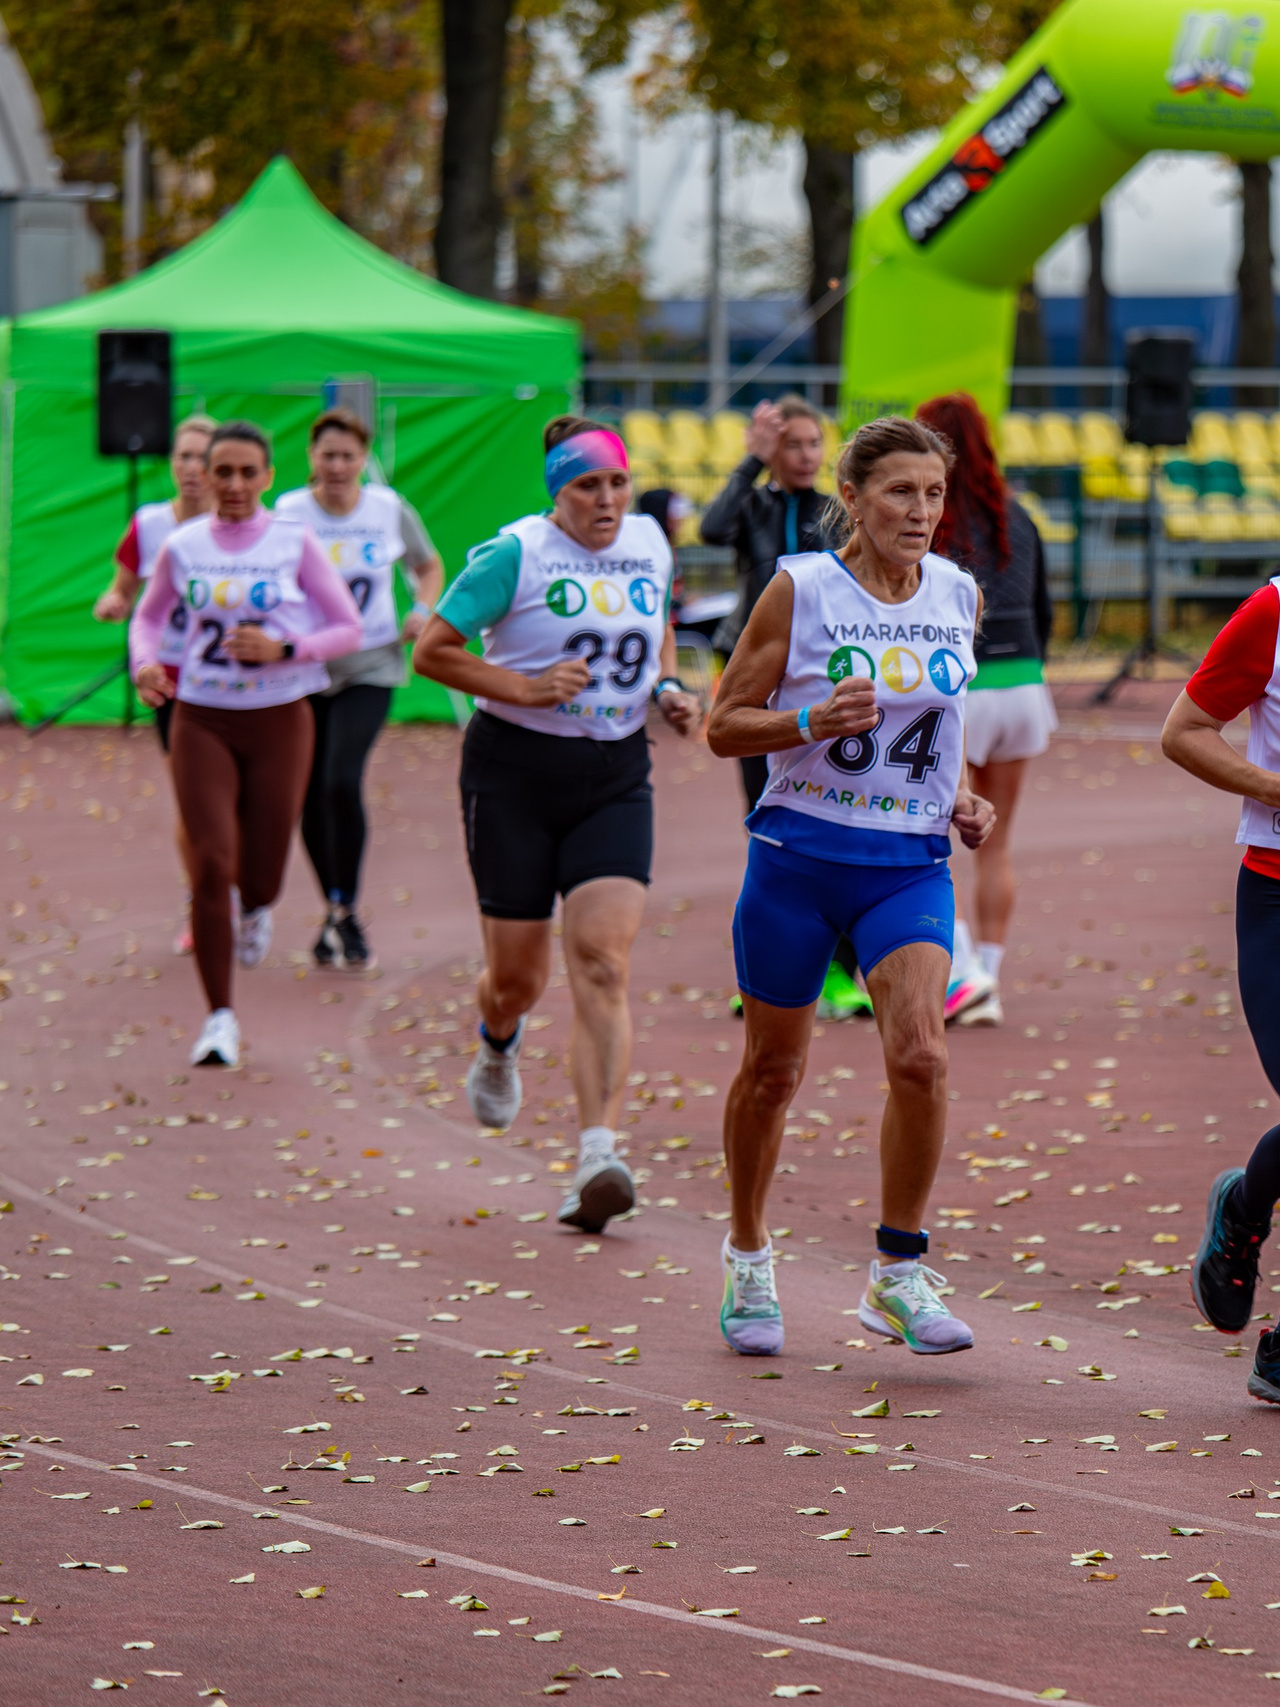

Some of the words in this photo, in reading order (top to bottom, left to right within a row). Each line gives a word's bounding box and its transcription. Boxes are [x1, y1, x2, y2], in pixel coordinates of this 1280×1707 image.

[201, 617, 268, 672] 2
[823, 623, 962, 645] VMARAFONE
[824, 706, 946, 785] 84
